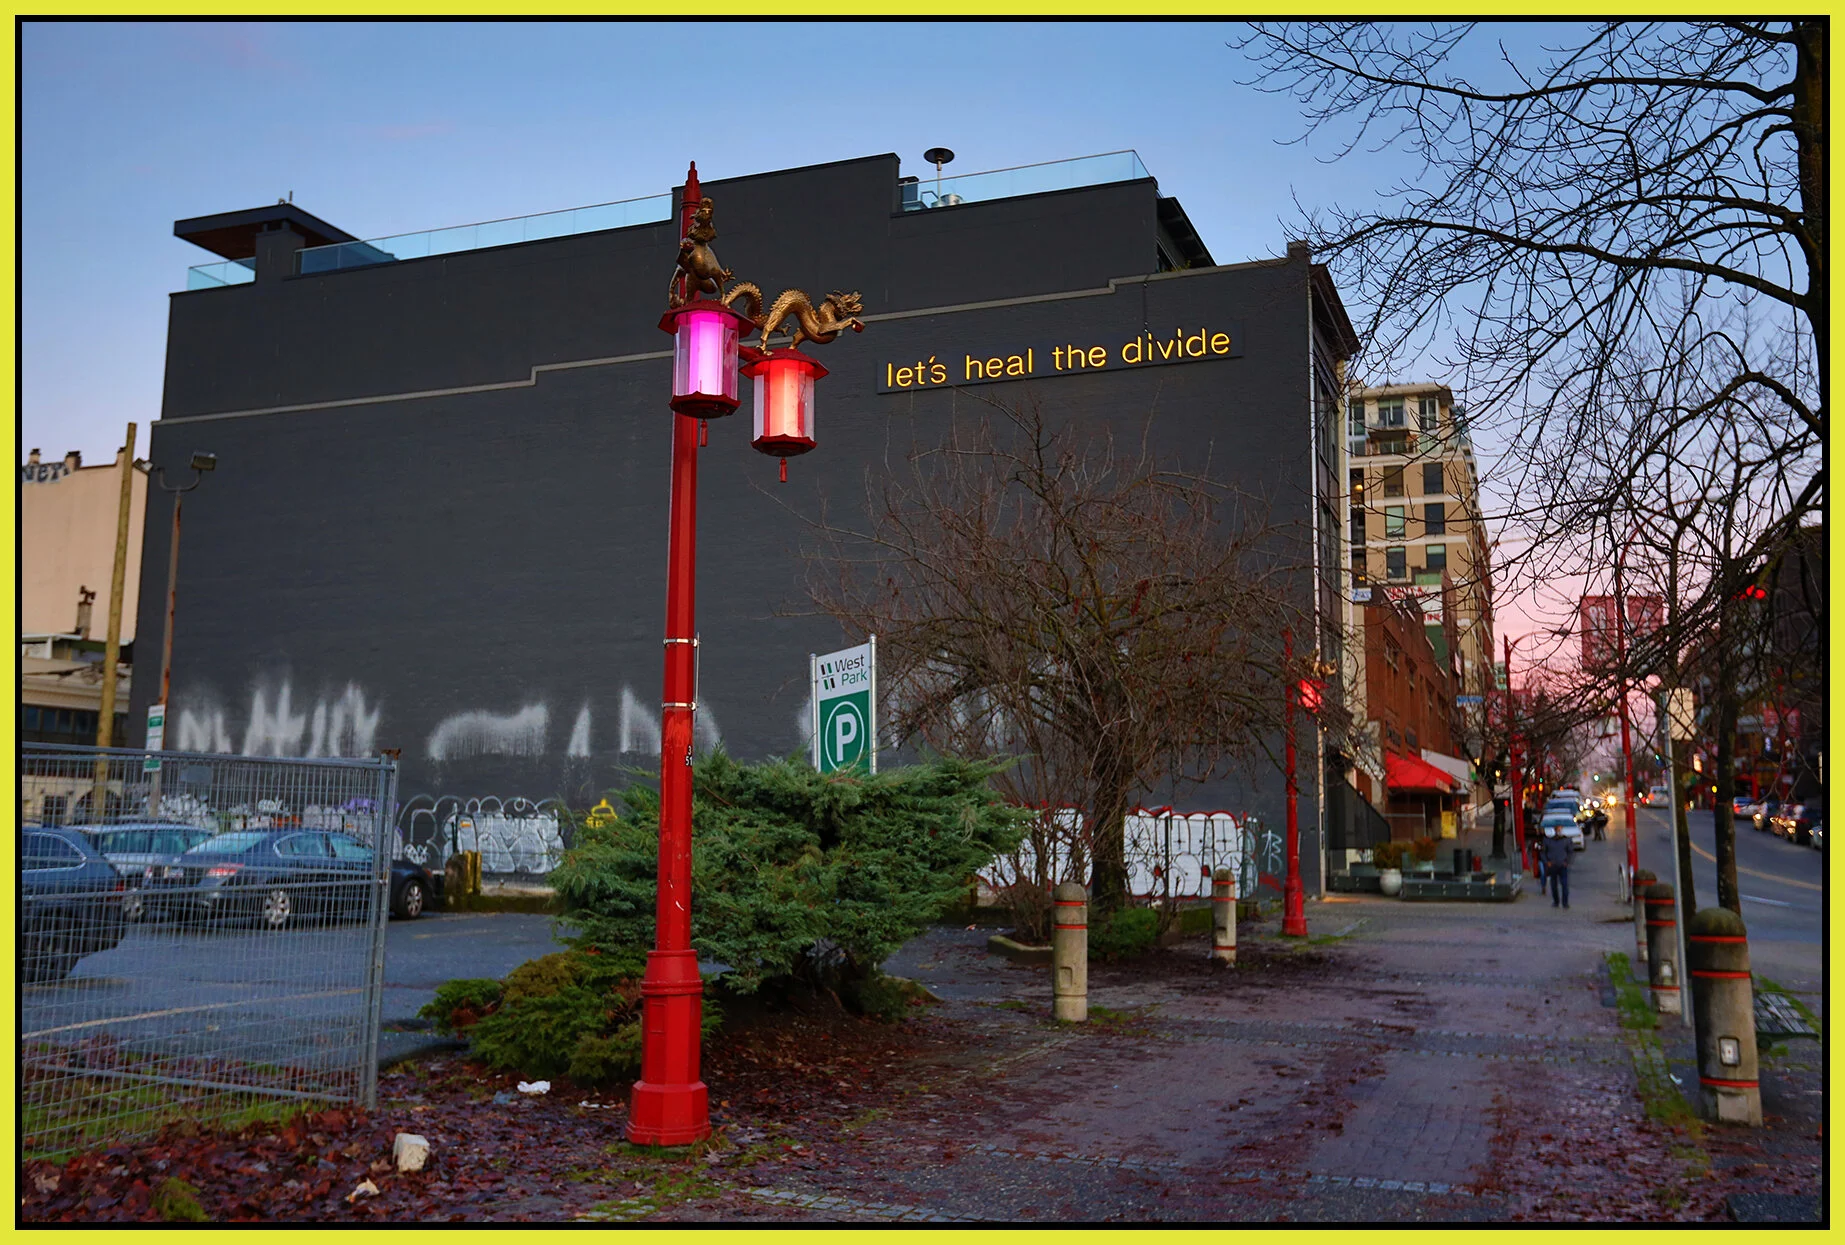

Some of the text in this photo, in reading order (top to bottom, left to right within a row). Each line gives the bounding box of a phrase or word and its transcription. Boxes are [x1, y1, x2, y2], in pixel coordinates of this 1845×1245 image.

[965, 348, 1034, 380] heal
[1052, 344, 1107, 371] the
[1122, 327, 1231, 364] divide
[835, 654, 864, 672] West
[841, 670, 868, 686] Park
[836, 713, 857, 762] P
